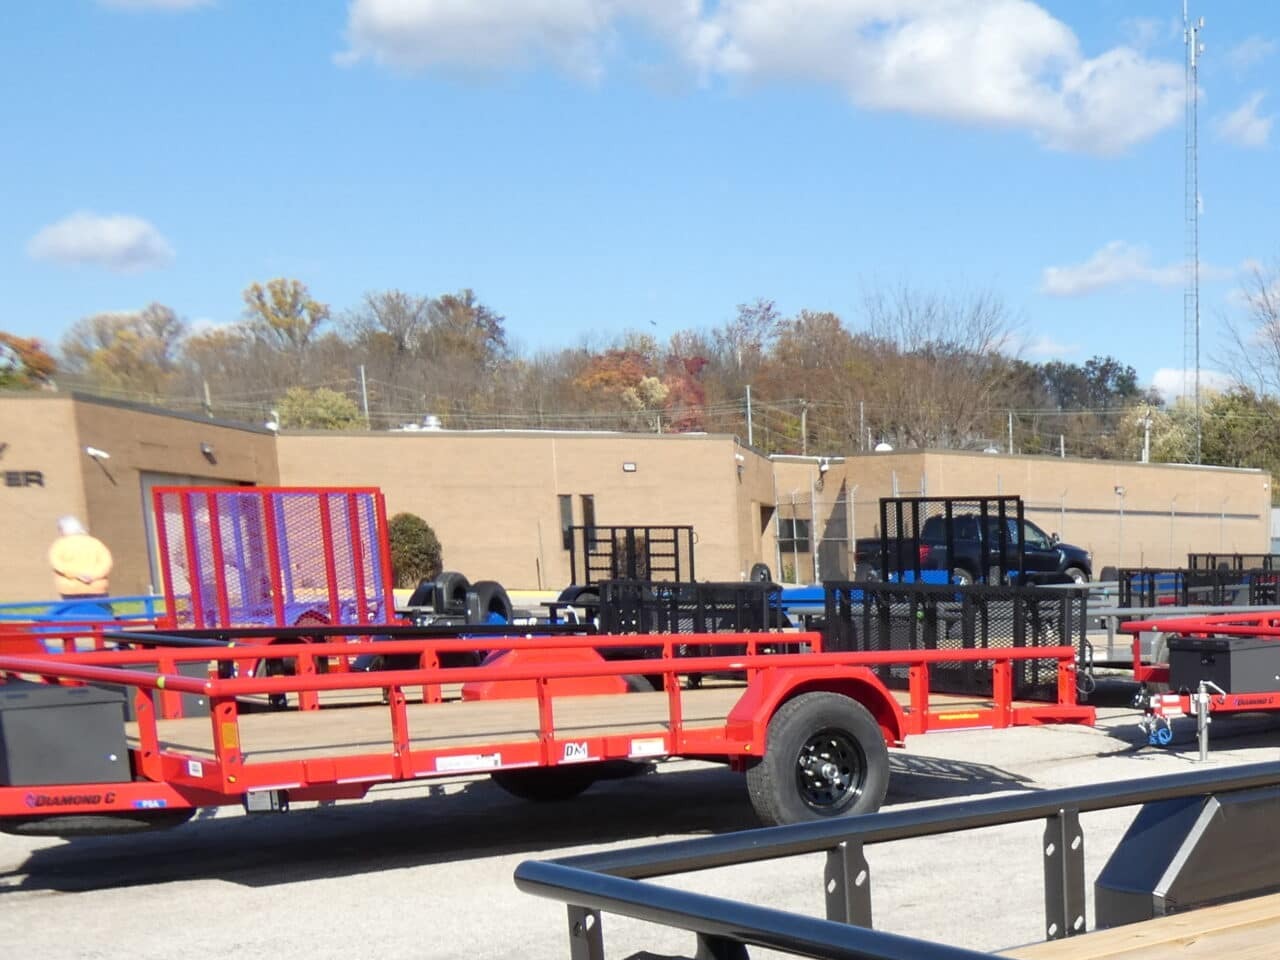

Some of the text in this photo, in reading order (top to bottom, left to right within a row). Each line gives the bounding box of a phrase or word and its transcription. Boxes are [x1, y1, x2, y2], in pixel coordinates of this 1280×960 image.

[566, 743, 588, 756] DM
[35, 791, 116, 807] DIAMOND C
